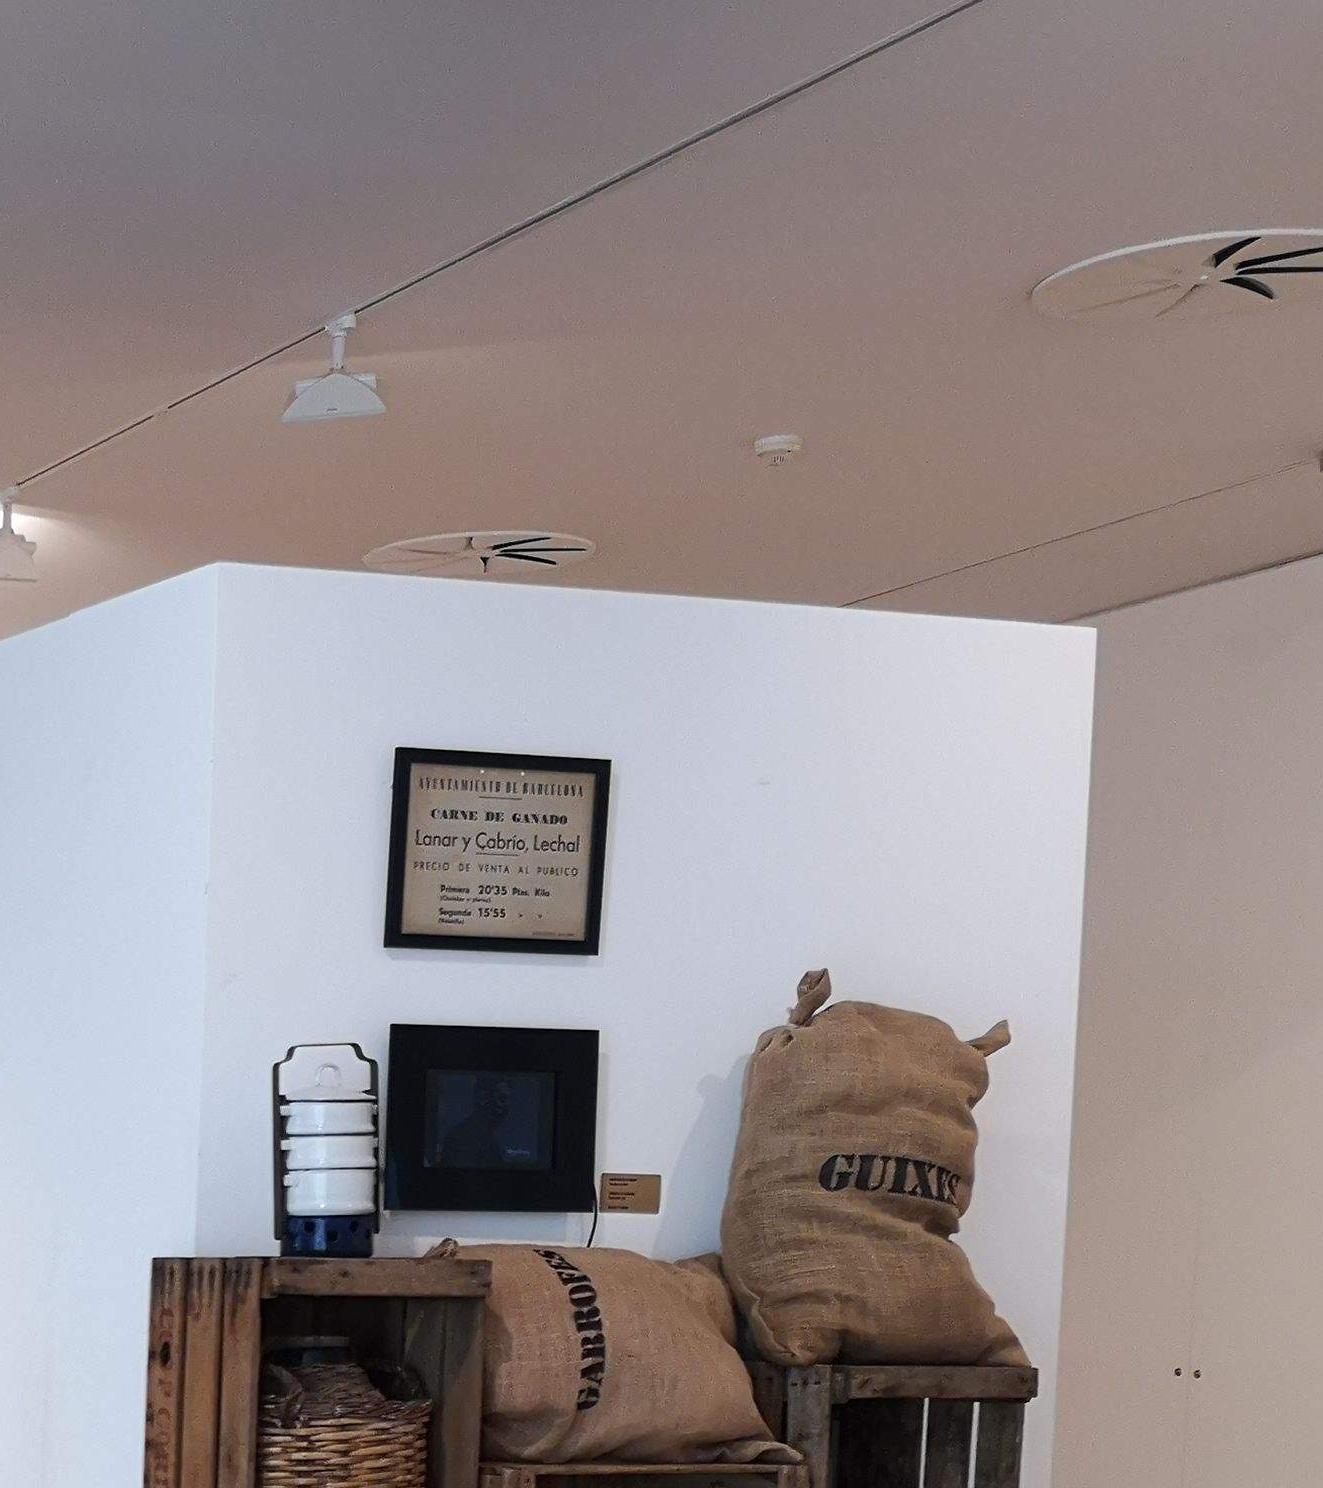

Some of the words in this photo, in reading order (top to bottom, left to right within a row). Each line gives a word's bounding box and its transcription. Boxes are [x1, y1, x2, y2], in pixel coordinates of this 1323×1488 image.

[506, 781, 518, 794] DE
[522, 782, 584, 797] BARCELONA
[431, 808, 478, 822] CARNE
[485, 811, 504, 823] DE
[512, 812, 568, 825] GANADO
[415, 829, 458, 847] Lanar
[462, 837, 471, 852] y
[534, 834, 580, 853] Lechal
[413, 861, 450, 871] PRECIO
[459, 863, 470, 872] DE
[478, 864, 510, 874] VENTA
[518, 866, 529, 875] AL
